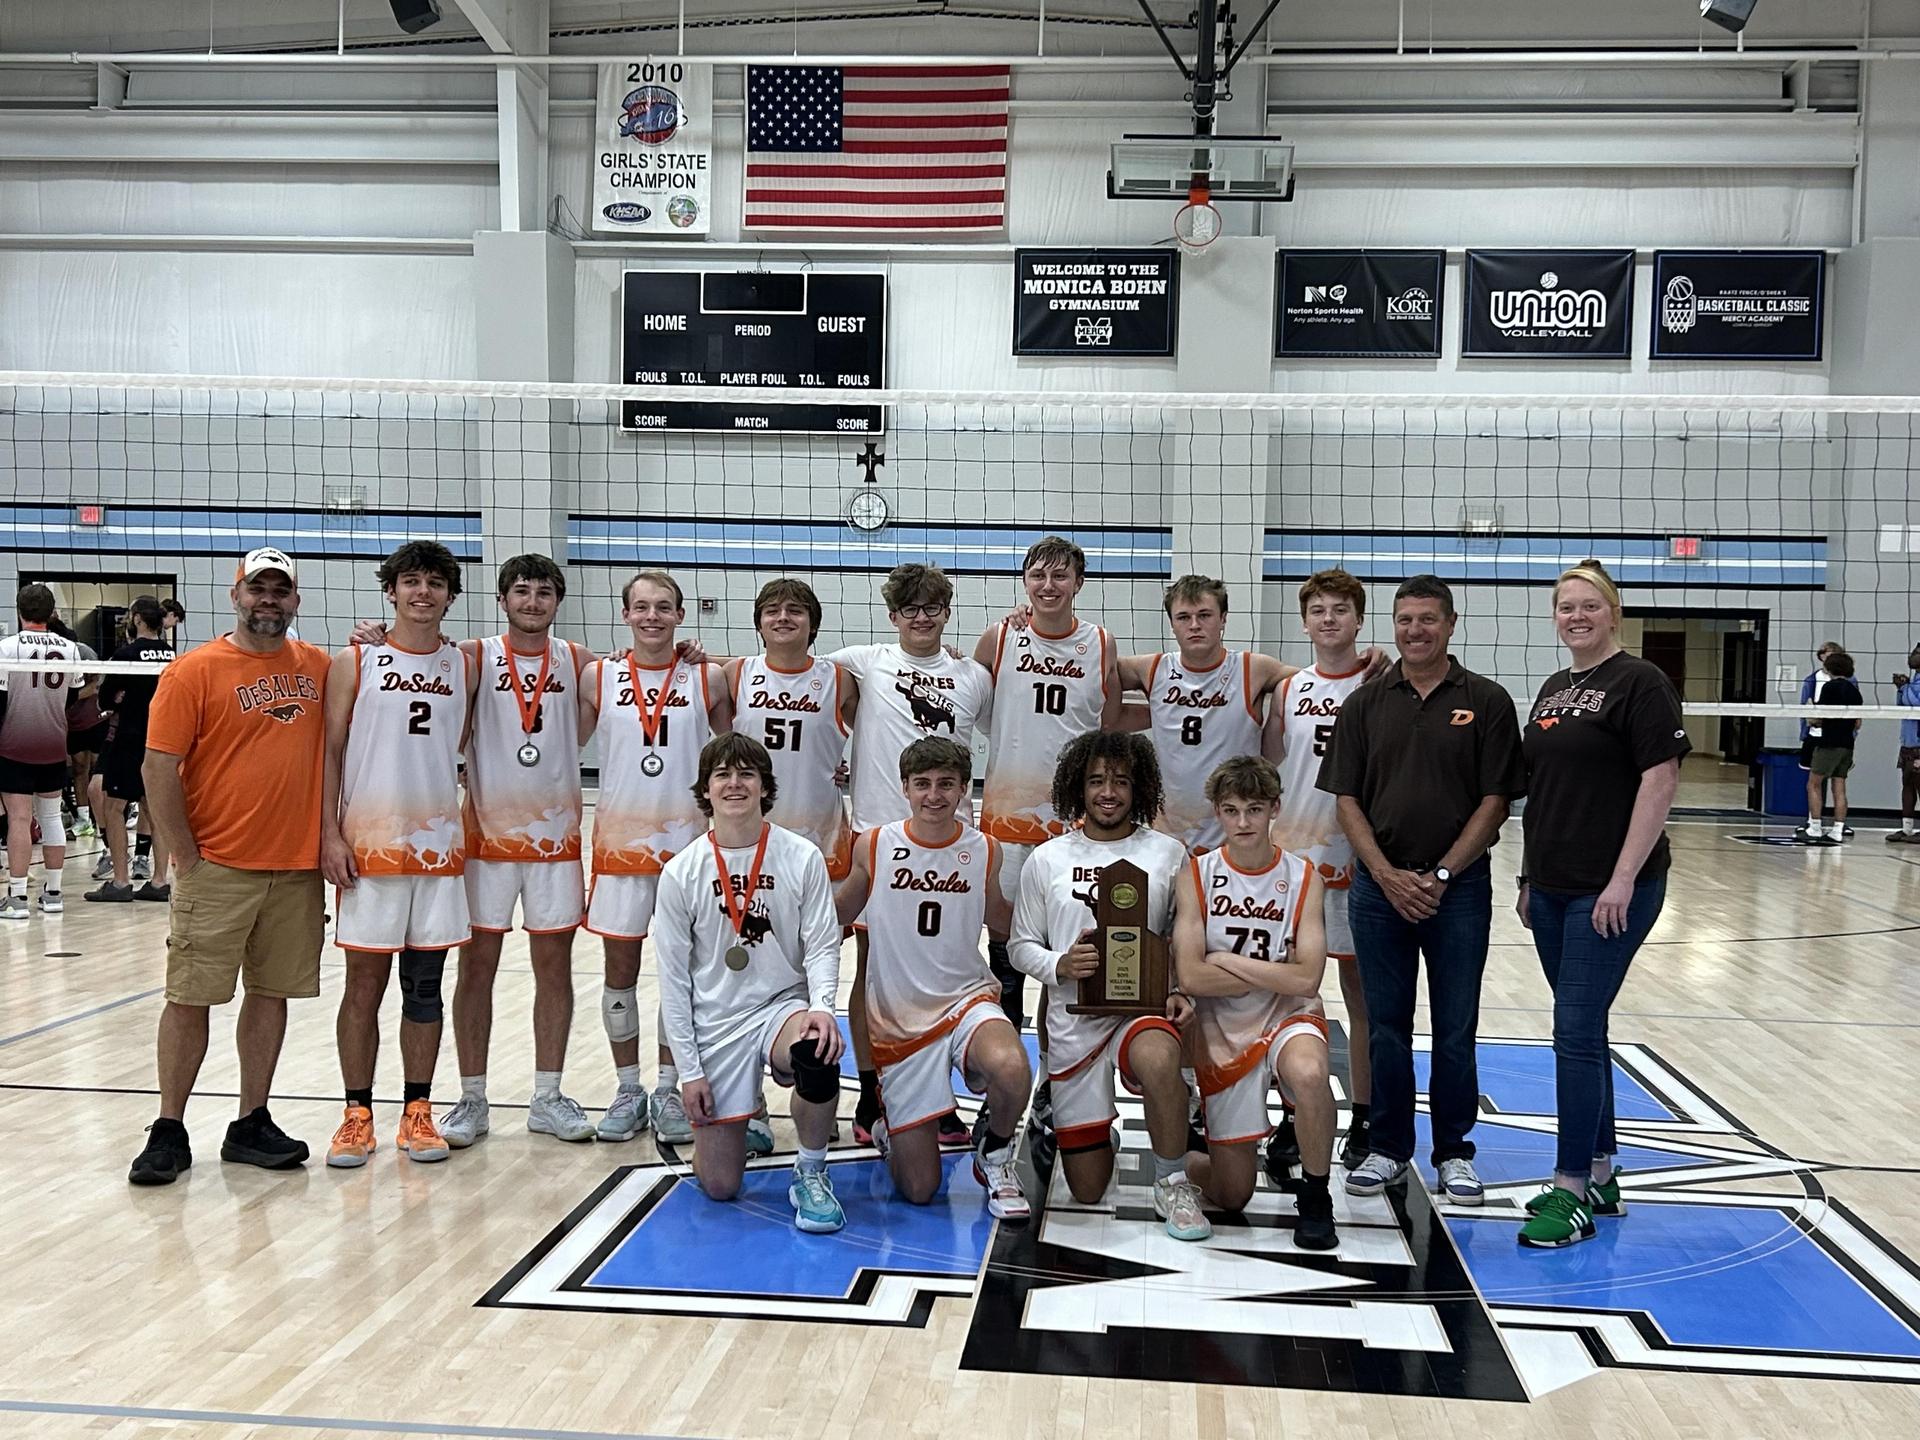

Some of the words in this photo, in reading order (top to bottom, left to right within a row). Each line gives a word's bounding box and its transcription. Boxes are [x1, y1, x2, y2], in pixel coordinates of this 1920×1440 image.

[626, 63, 684, 83] 2010
[600, 152, 653, 169] GIRLS'
[656, 153, 707, 170] STATE
[609, 172, 697, 190] CHAMPION
[1032, 264, 1105, 276] WELCOME
[1107, 264, 1127, 276] TO
[1129, 264, 1160, 276] THE
[1023, 279, 1106, 295] MONICA
[1109, 279, 1167, 295] BOHN
[1049, 299, 1140, 311] GYMNASIUM
[1287, 307, 1313, 315] Norton
[1314, 307, 1339, 316] Sports
[1339, 307, 1364, 315] Health
[1386, 296, 1434, 313] KORT
[1697, 299, 1764, 312] BASKETBALL
[1766, 300, 1810, 312] CLASSIC
[643, 314, 687, 331] HOME
[817, 316, 866, 333] GUEST
[1721, 315, 1747, 323] MERCY
[1748, 315, 1785, 323] ACADEMY
[734, 324, 772, 337] PERIOD
[1076, 326, 1111, 336] MERCY
[1501, 329, 1593, 338] VOLLEYBALL
[635, 371, 668, 384] FOULS
[680, 372, 706, 384] T.O.L.
[720, 372, 758, 385] PLAYER
[761, 373, 787, 386] FOUL
[799, 373, 825, 386] T.O.L.
[837, 374, 870, 387] FOULS
[634, 415, 667, 428] SCORE
[734, 417, 769, 429] MATCH
[836, 418, 869, 431] SCORE
[19, 633, 67, 649] COUGARS
[1016, 653, 1085, 679] DeSales
[380, 671, 454, 696] DeSales
[495, 672, 565, 693] DSles
[616, 688, 690, 708] DSles
[748, 690, 821, 713] DeSales
[1032, 681, 1068, 717] 10
[408, 700, 432, 736] 2
[1450, 708, 1475, 726] D
[763, 716, 803, 752] 51
[1180, 714, 1202, 746] 8
[892, 847, 911, 861] D
[890, 867, 971, 894] DeSales
[1212, 875, 1229, 889] D
[1210, 894, 1285, 922] DeSales
[916, 900, 943, 938] 0
[1225, 926, 1272, 962] 73
